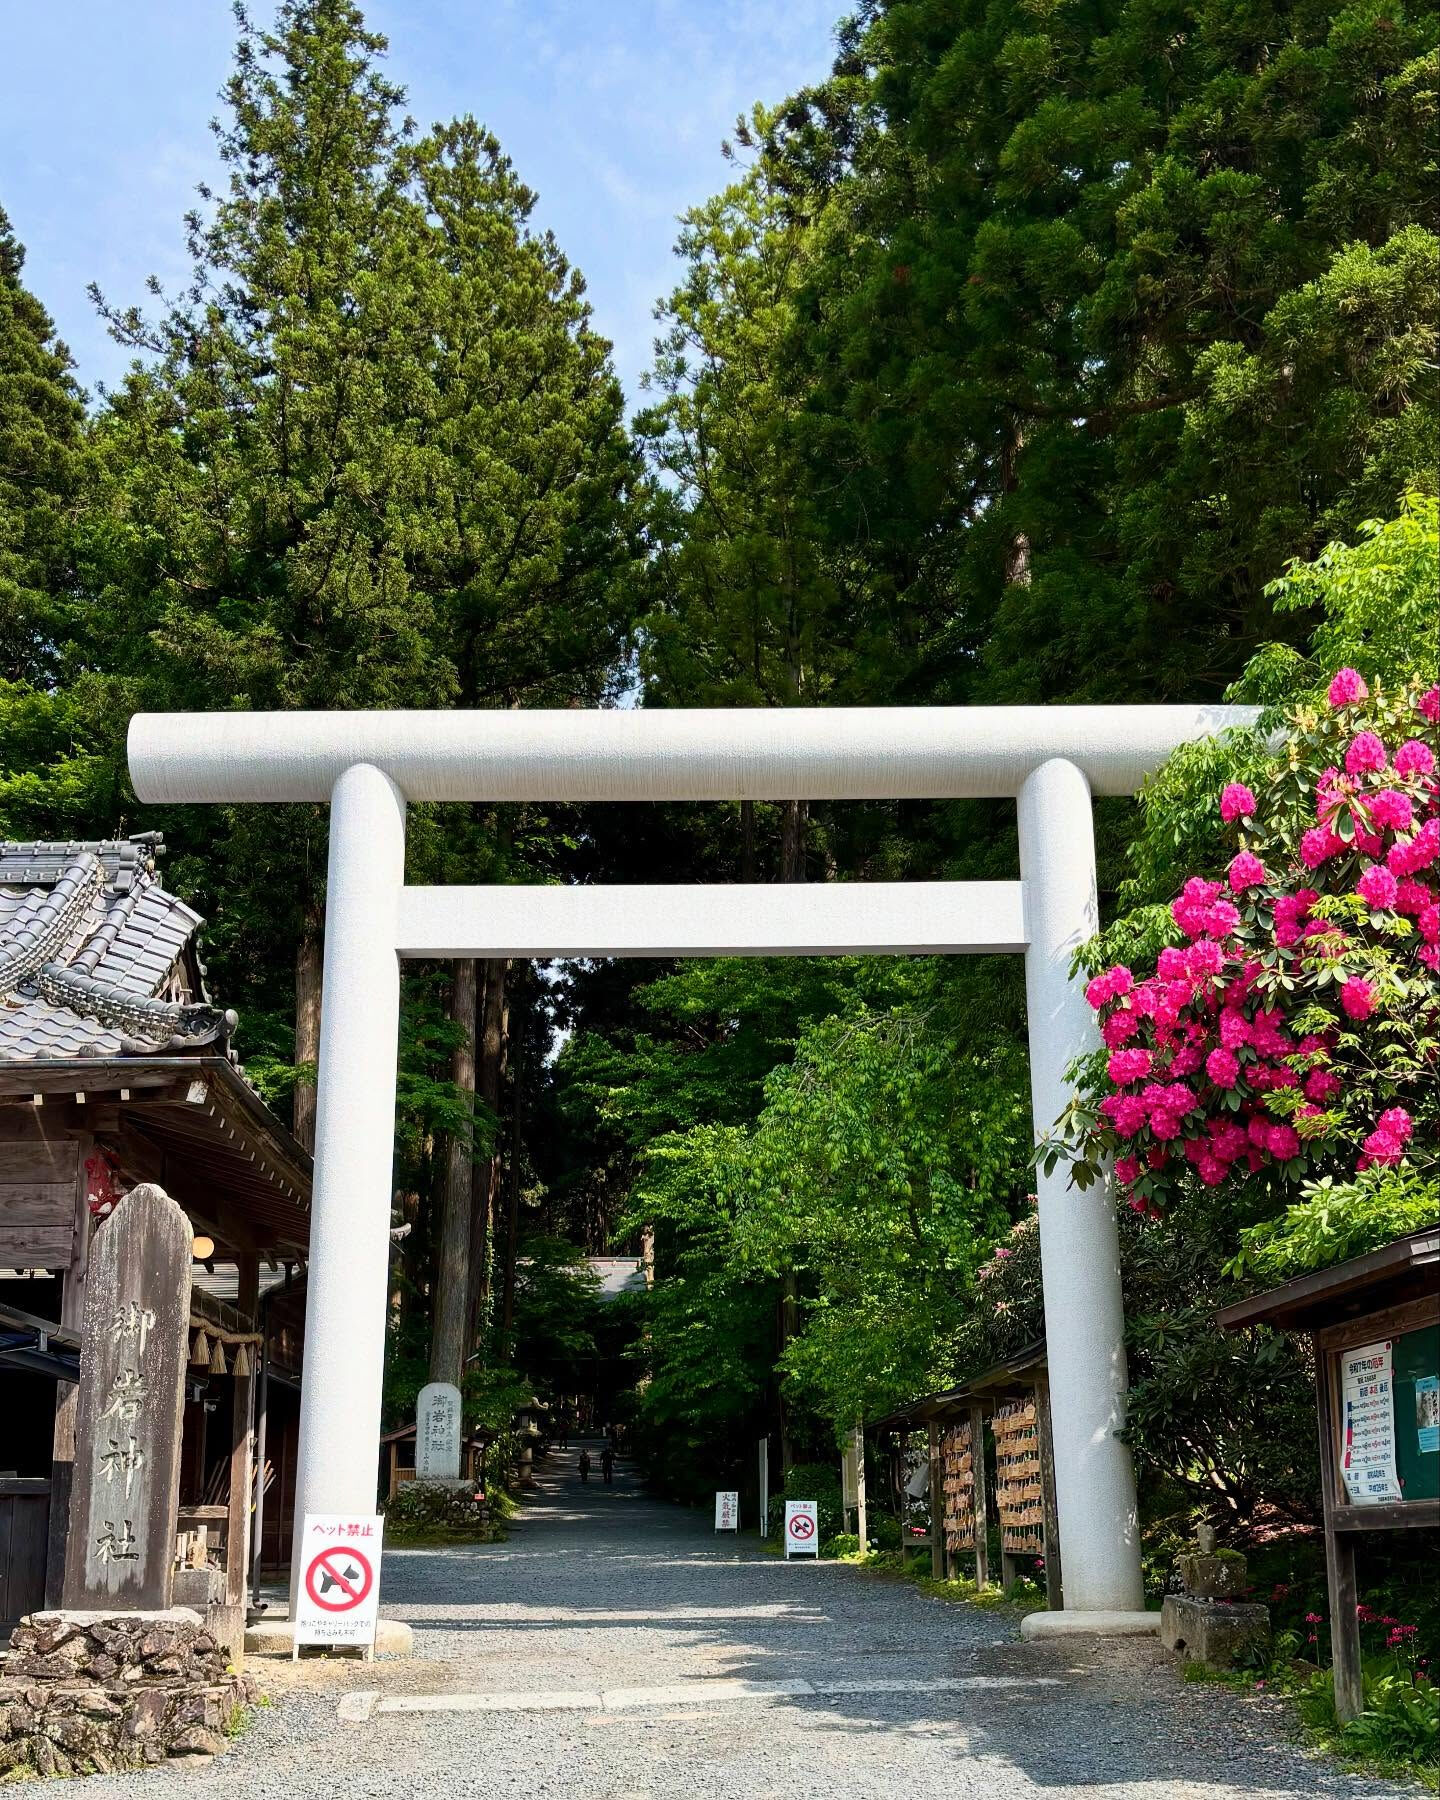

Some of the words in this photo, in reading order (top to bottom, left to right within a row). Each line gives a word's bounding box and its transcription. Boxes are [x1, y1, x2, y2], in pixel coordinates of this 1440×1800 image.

[92, 1300, 157, 1565] 御岩神社
[431, 1394, 448, 1452] 御岩神社
[312, 1523, 374, 1537] ペット禁止
